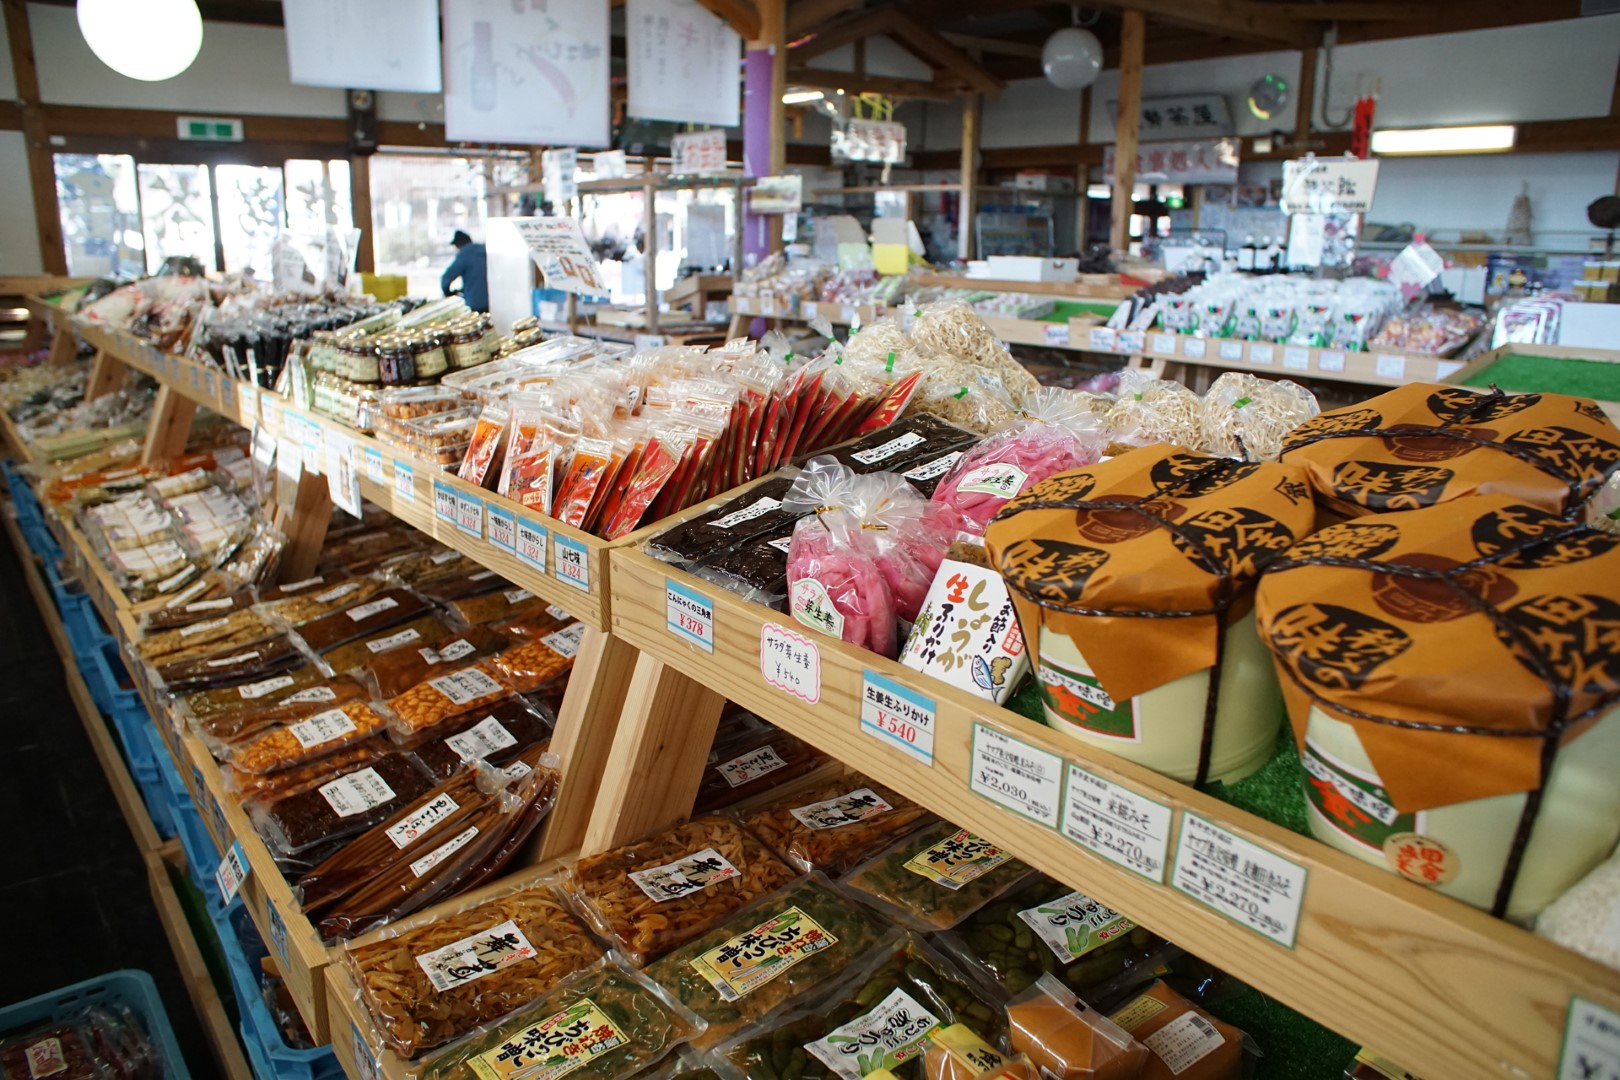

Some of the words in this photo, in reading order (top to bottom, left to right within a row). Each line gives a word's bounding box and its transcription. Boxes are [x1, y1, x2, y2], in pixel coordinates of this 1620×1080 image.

[562, 547, 580, 565] 山七味
[562, 562, 581, 580] ¥324
[667, 592, 712, 621] こんにゃくの三角煮
[679, 613, 704, 637] ¥378
[936, 579, 992, 672] しょうが
[775, 661, 800, 685] ¥540
[866, 686, 930, 726] 生姜生ふりかけ
[877, 711, 916, 743] ¥540
[980, 769, 1028, 800] ¥2,030
[717, 933, 762, 963] 味噌
[732, 926, 801, 967] ちびっこ
[777, 929, 824, 955] 焼ねぎ
[496, 1028, 546, 1062] 味噌
[563, 1024, 615, 1056] 焼ねぎ
